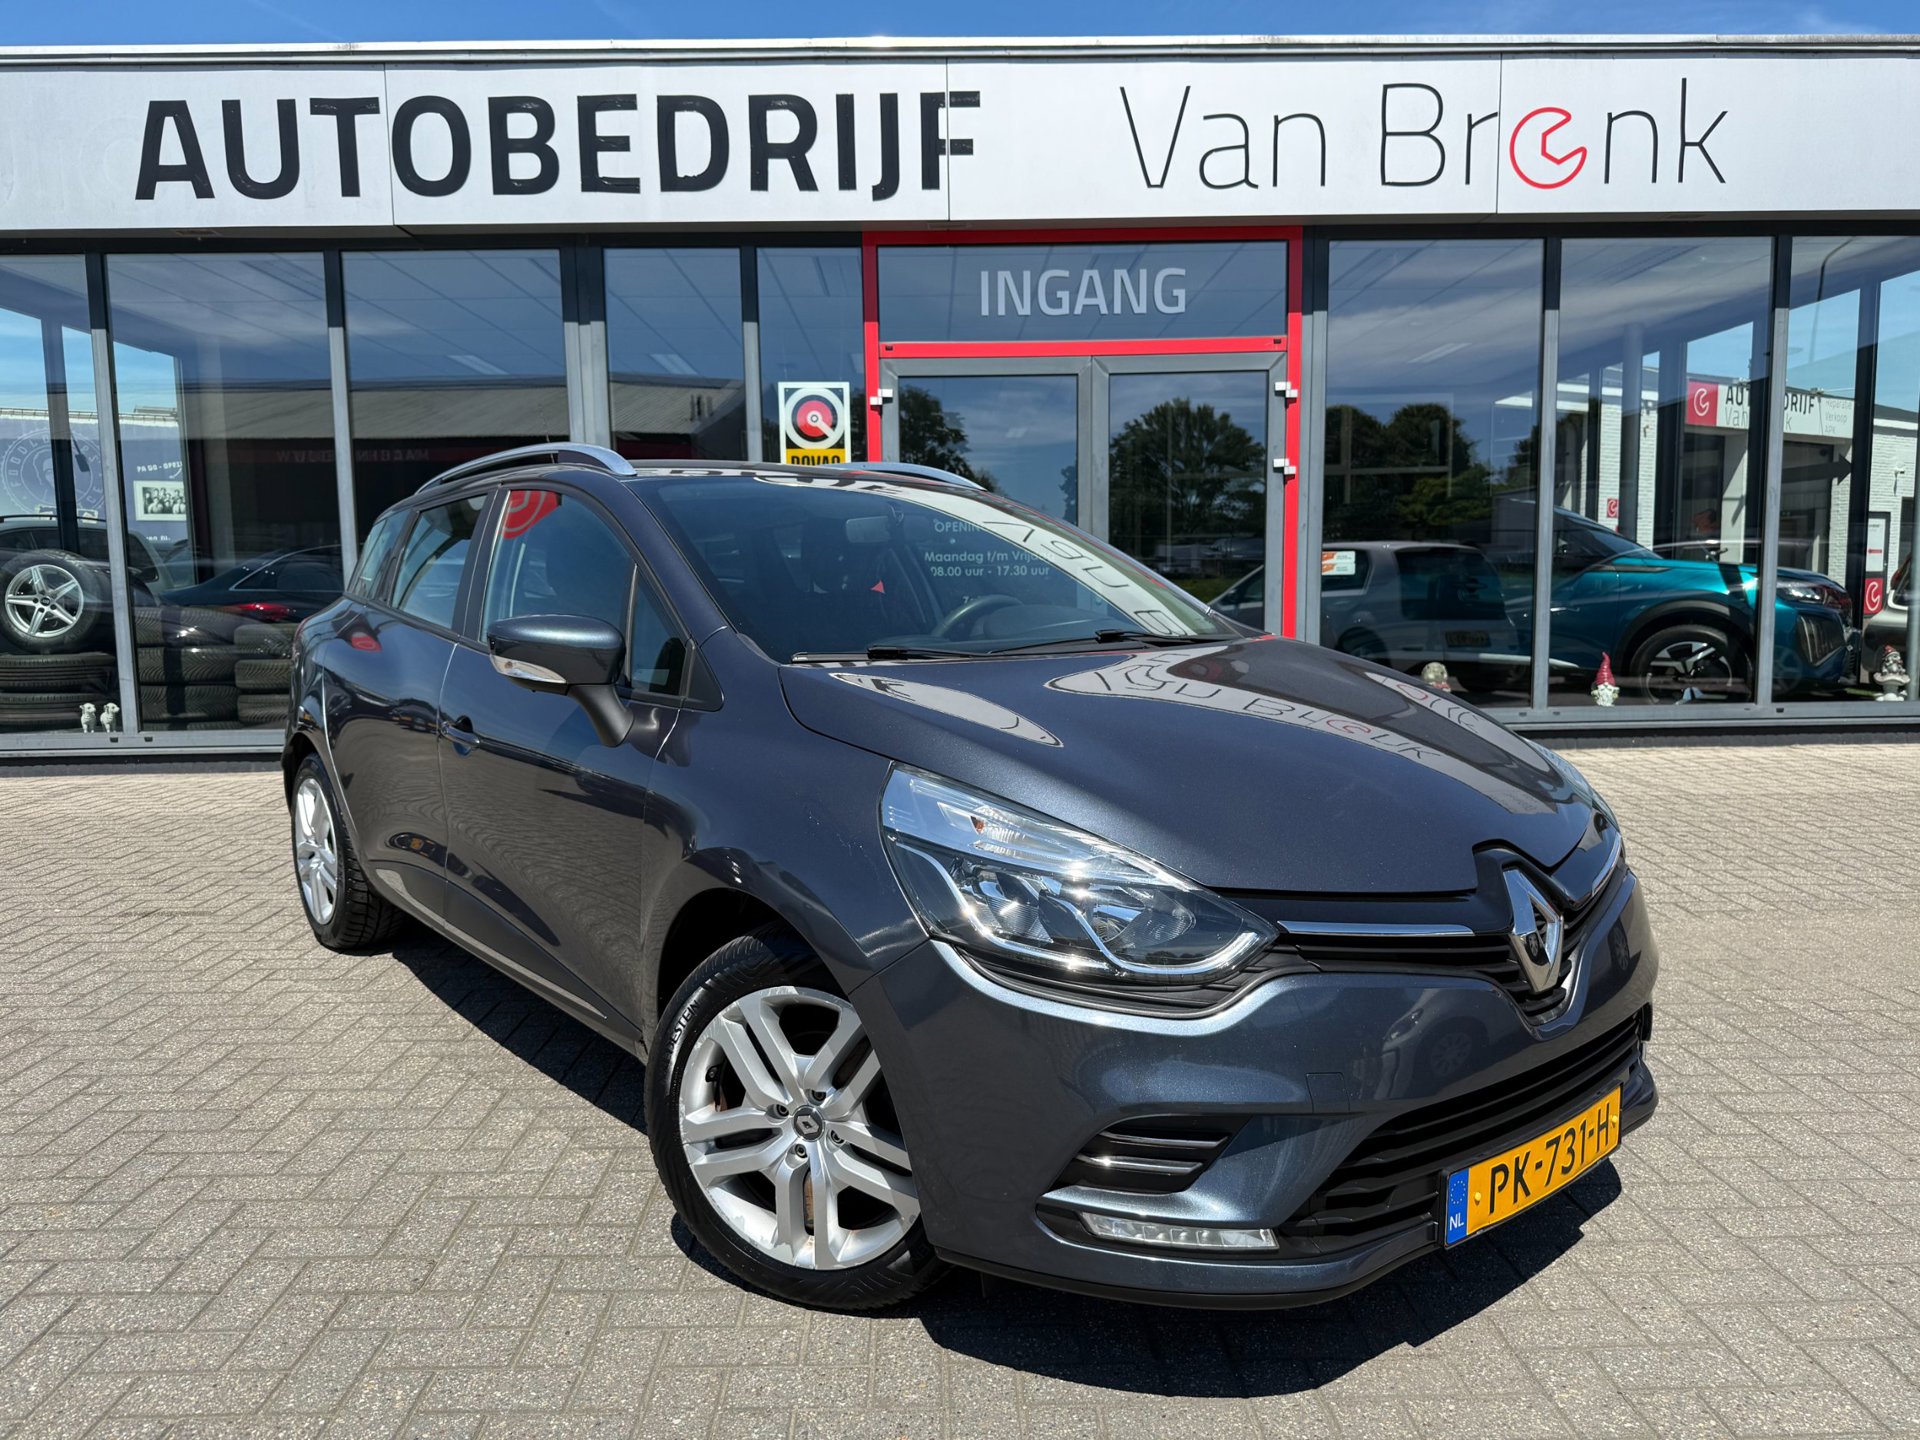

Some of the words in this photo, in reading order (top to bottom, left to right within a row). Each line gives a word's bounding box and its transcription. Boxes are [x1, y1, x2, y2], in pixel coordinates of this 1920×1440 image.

[136, 91, 981, 202] AUTOBEDRIJF
[1120, 85, 1326, 190] Van
[981, 267, 1186, 316] INGANG
[924, 552, 983, 563] Maandag
[987, 551, 1008, 563] t/m
[965, 568, 984, 576] uur
[997, 565, 1027, 576] 17.30
[1031, 567, 1050, 576] uur
[1449, 1213, 1465, 1231] NL
[1489, 1102, 1610, 1216] PK-731-H
